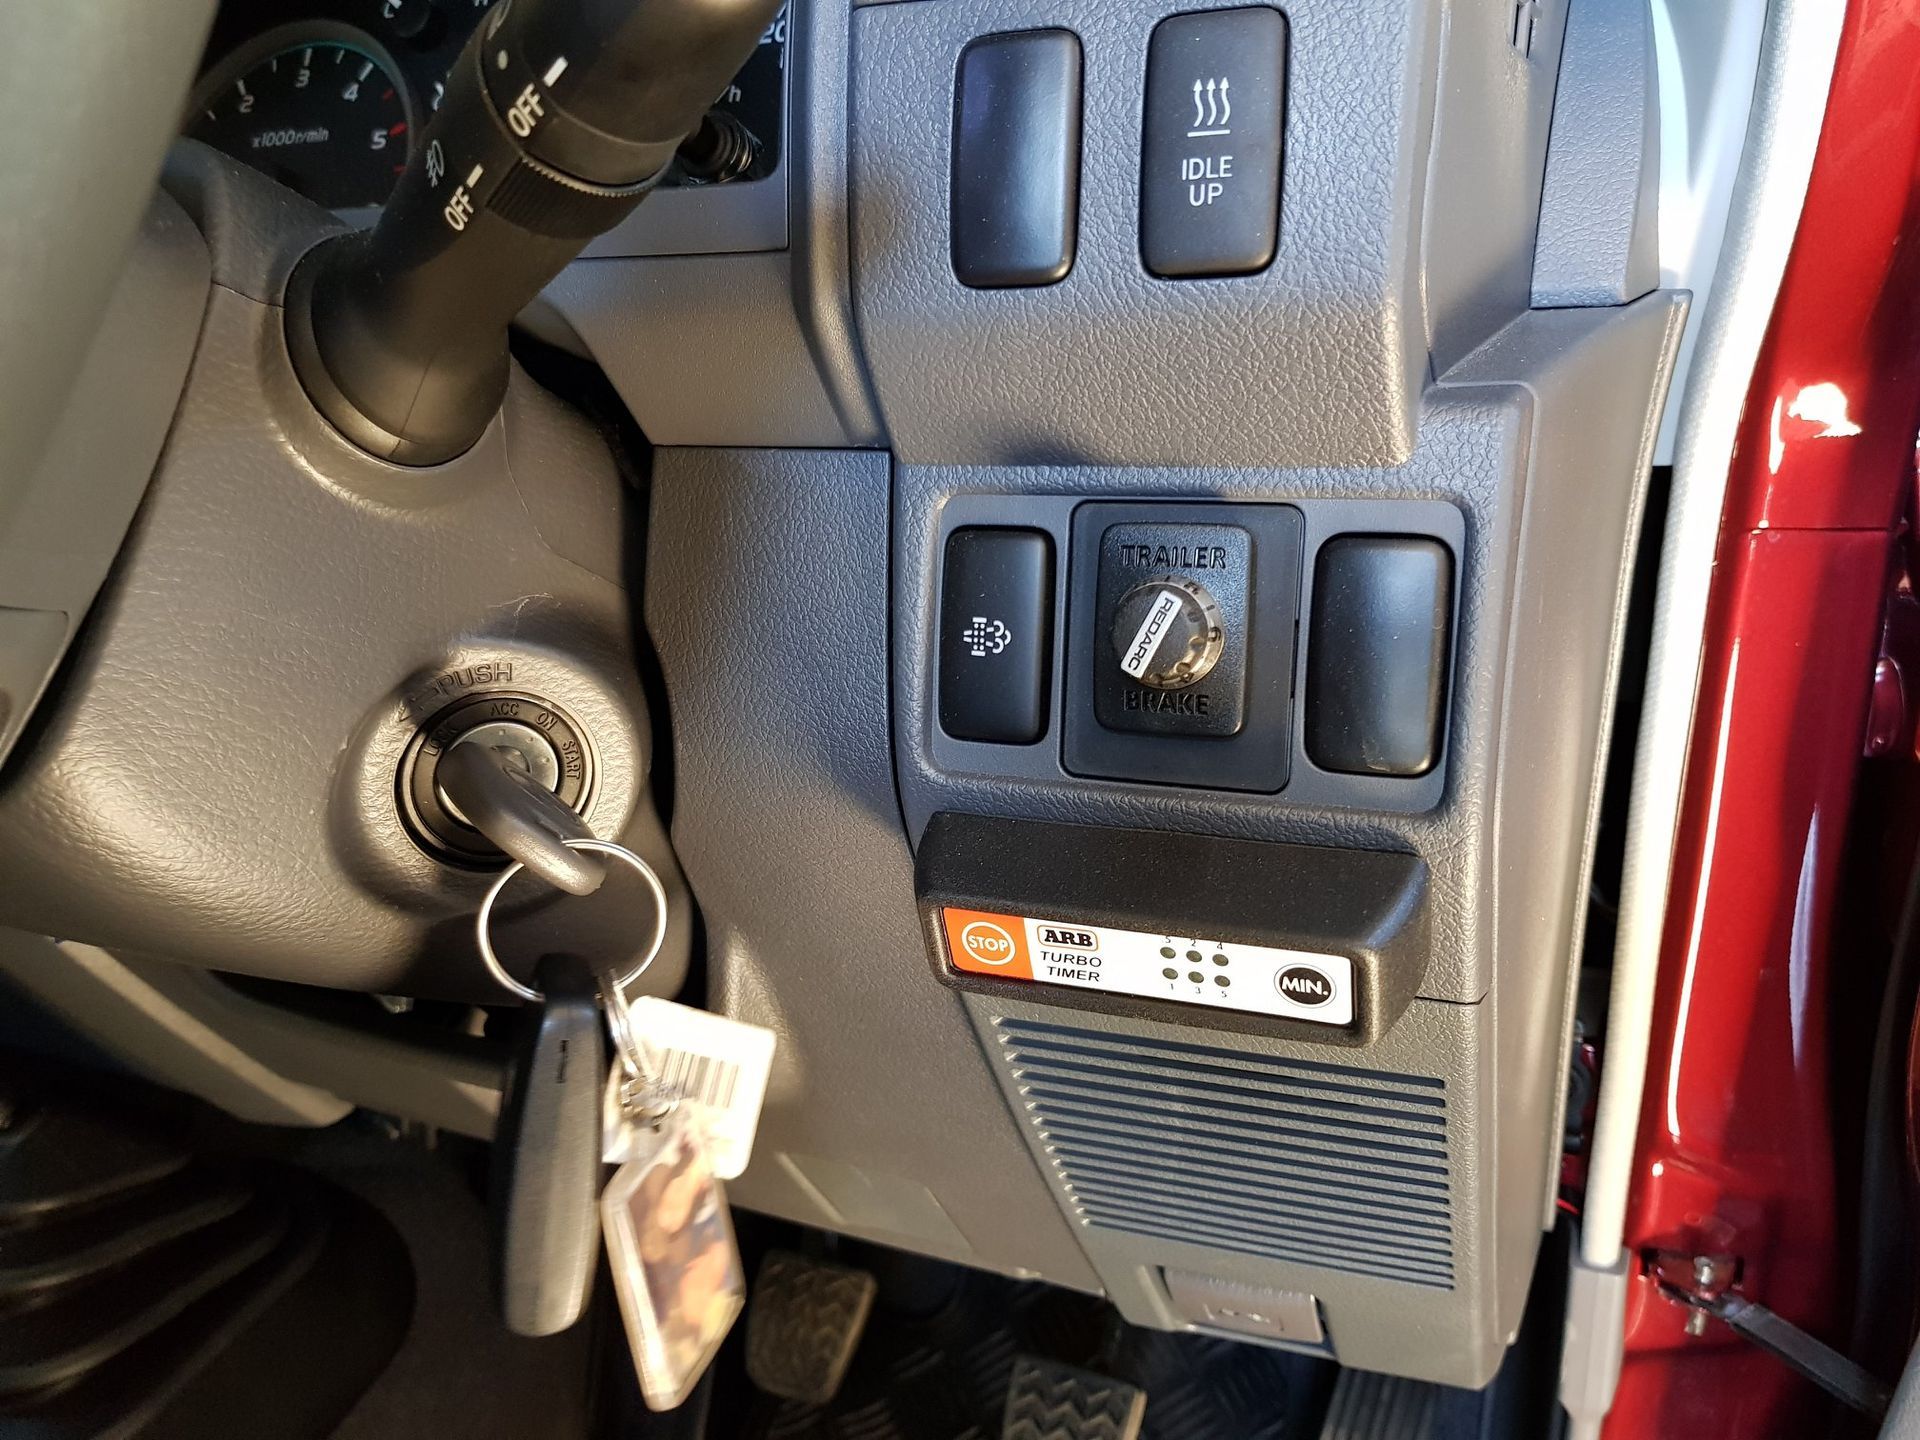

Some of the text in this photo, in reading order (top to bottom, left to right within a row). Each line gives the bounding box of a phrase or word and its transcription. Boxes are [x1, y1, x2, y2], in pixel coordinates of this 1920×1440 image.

[295, 69, 310, 88] 3
[342, 82, 359, 102] 4
[239, 94, 254, 113] 2
[508, 83, 545, 137] OFF
[371, 129, 388, 149] 5
[1181, 156, 1233, 180] IDLE
[1189, 183, 1223, 206] UP
[444, 185, 474, 231] OFF
[1120, 545, 1227, 569] TRAILER
[1127, 597, 1174, 671] REDARC
[436, 663, 512, 696] PUSH
[490, 703, 520, 717] ACC
[1122, 689, 1210, 717] BRAKE
[535, 711, 559, 732] ON
[561, 739, 582, 780] START
[967, 935, 1009, 953] STOP
[1044, 929, 1093, 947] ARB
[1040, 951, 1102, 968] TURBO
[1047, 966, 1100, 982] TIMER
[1281, 975, 1329, 996] MIN.
